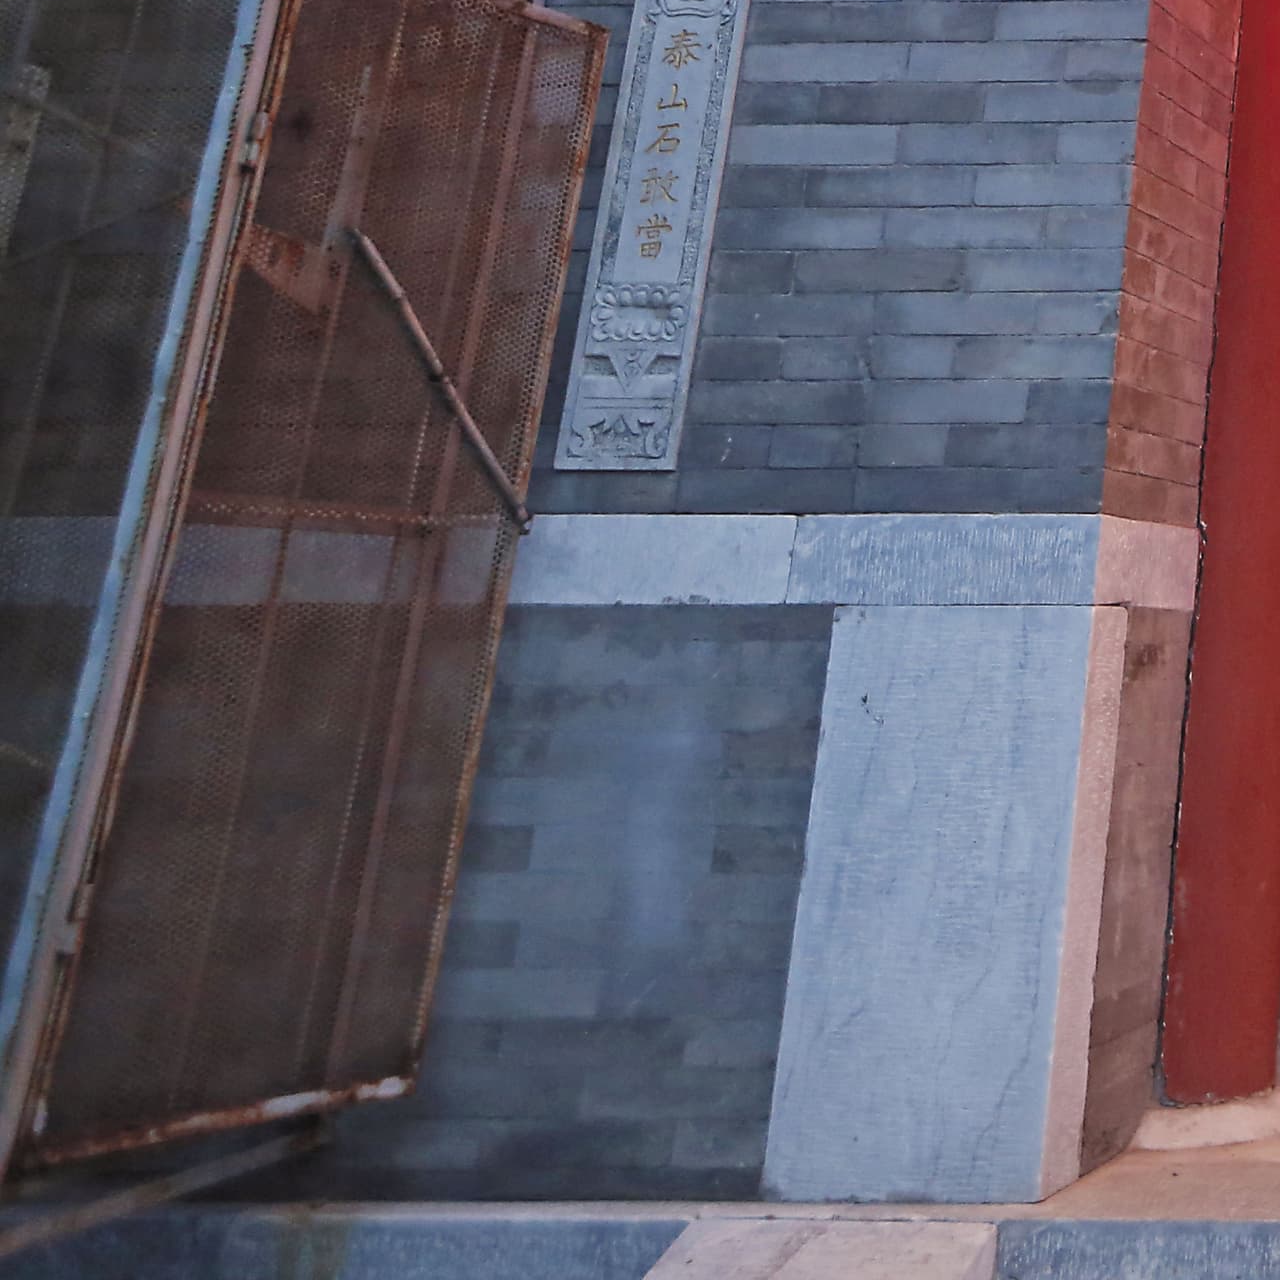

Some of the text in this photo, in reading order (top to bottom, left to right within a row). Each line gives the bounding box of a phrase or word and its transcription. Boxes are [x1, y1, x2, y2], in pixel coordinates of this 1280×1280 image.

[637, 29, 701, 260] 泰山石敢當
